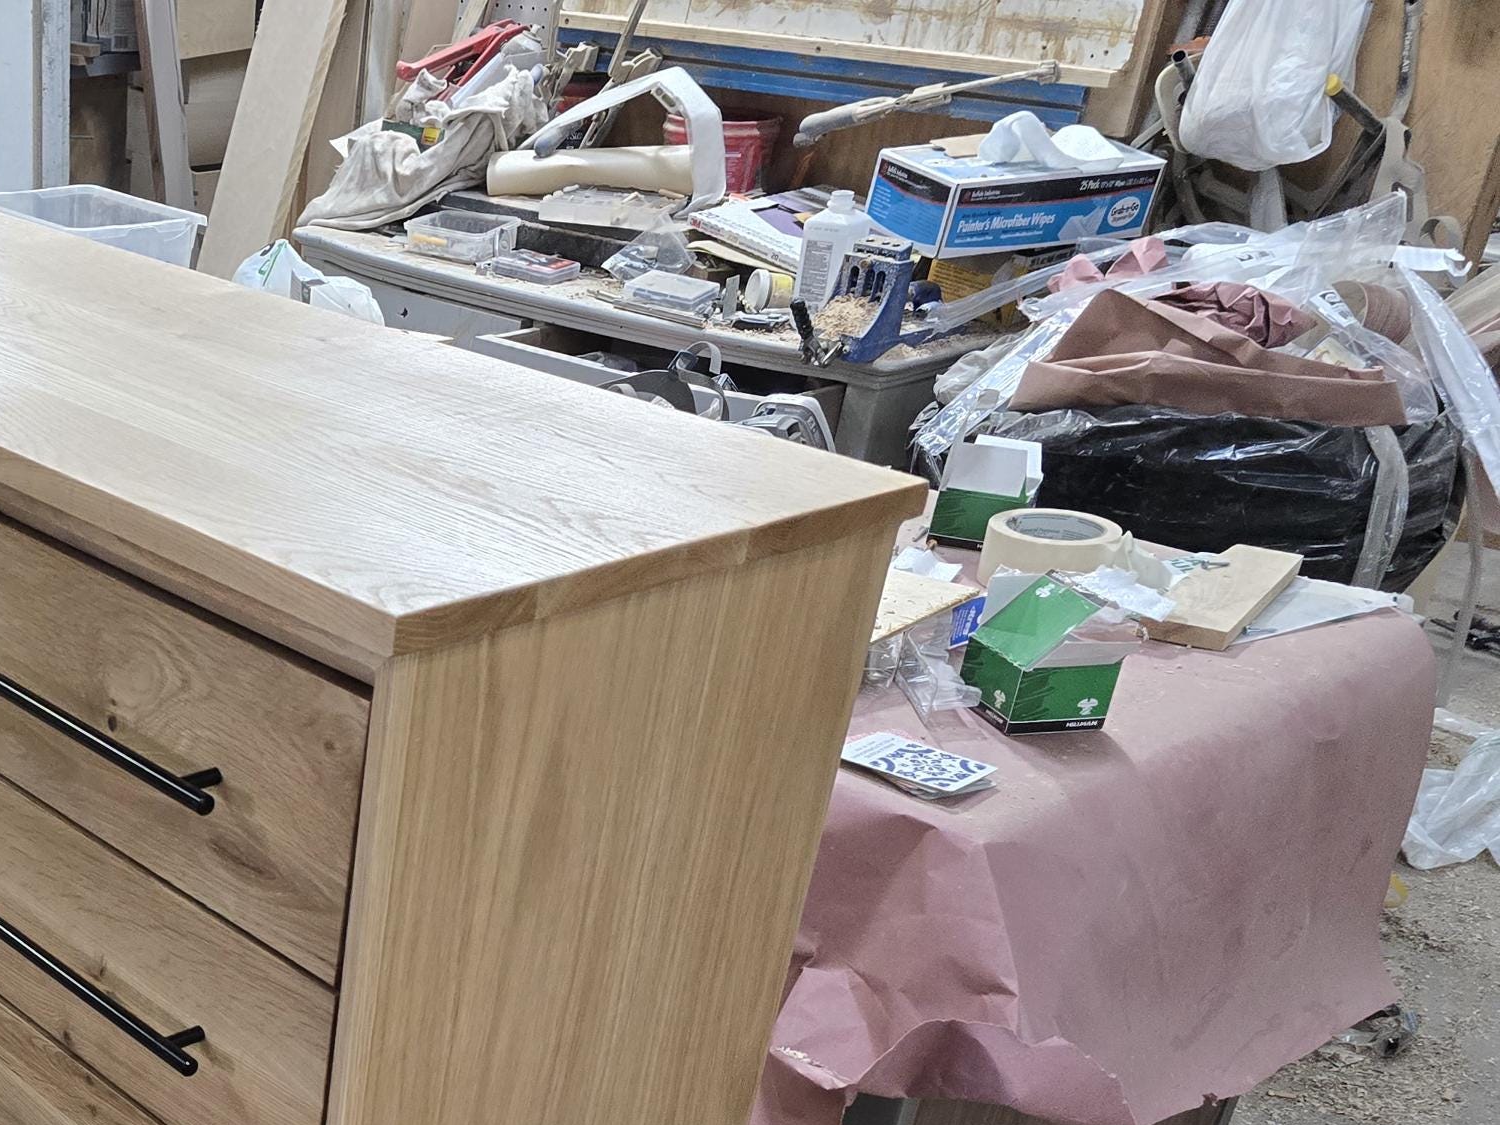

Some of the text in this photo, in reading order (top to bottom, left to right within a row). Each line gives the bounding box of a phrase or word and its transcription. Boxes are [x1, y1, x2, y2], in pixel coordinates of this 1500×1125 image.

[957, 218, 990, 233] Painter's
[991, 213, 1030, 230] Microfiber
[1030, 213, 1056, 230] Wipes
[1065, 720, 1098, 728] HILLMAN
